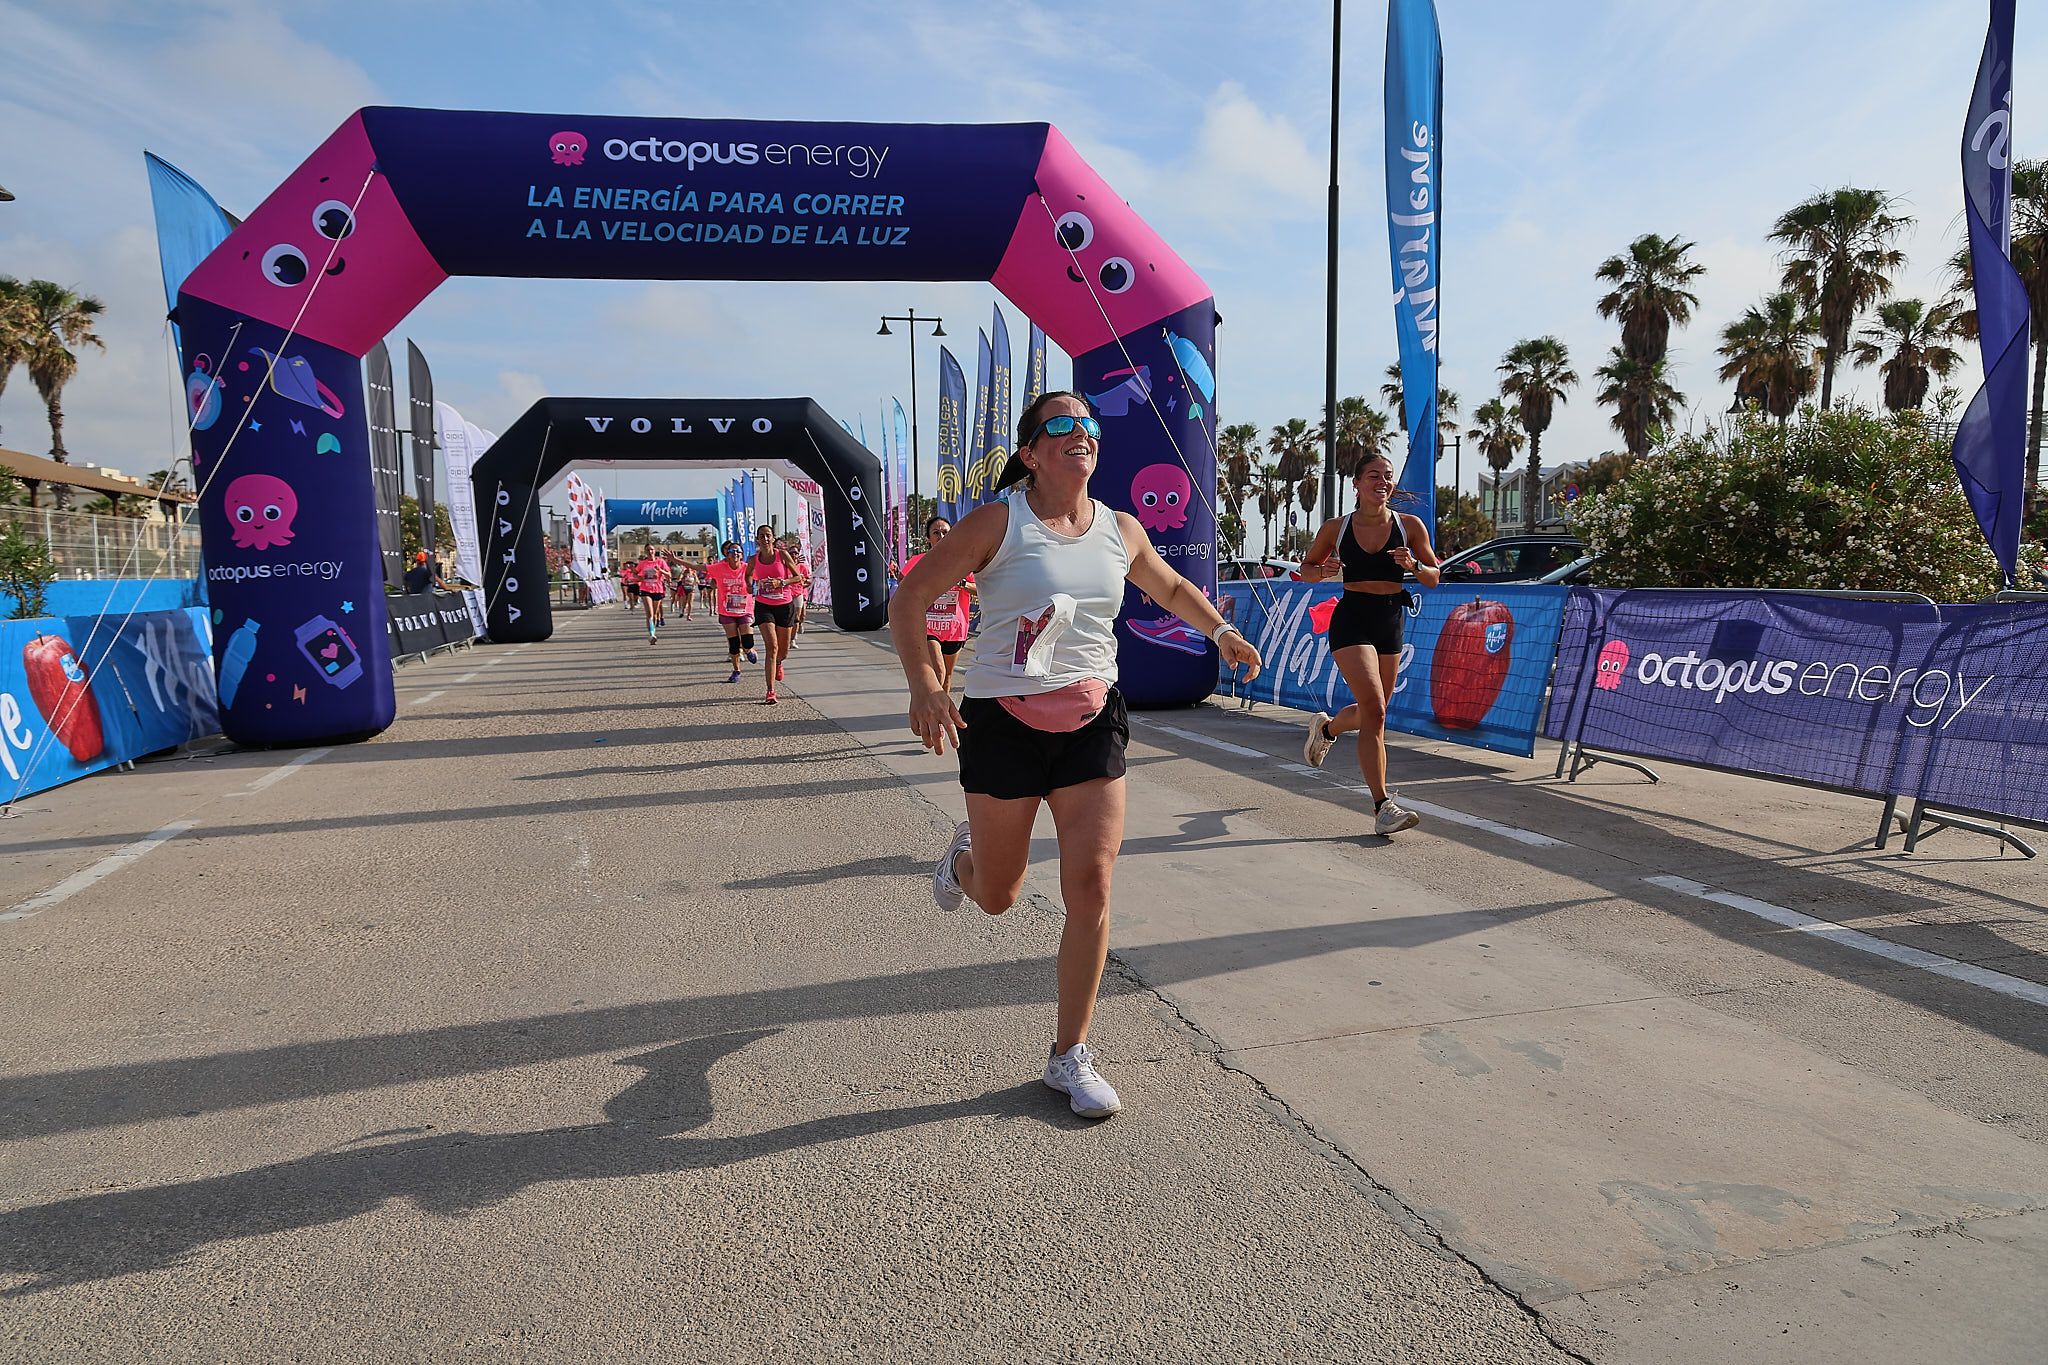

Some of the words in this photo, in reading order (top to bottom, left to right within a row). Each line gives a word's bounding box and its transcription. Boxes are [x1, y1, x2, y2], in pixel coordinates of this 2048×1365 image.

[603, 136, 760, 171] octopus
[764, 143, 889, 178] energy
[527, 185, 564, 208] LA
[573, 184, 699, 212] ENERGÍA
[708, 190, 785, 214] PARA
[793, 193, 905, 216] CORRER
[526, 218, 546, 239] A
[555, 219, 591, 240] LA
[601, 220, 764, 243] VELOCIDAD
[771, 225, 808, 244] DE
[815, 225, 849, 245] LA
[857, 226, 910, 246] LUZ
[584, 417, 773, 434] VOLVO
[640, 501, 689, 522] Marlene
[497, 490, 522, 624] VOLVO
[850, 486, 870, 612] VOLVO
[1168, 542, 1212, 560] energy
[208, 565, 272, 583] octopus
[272, 561, 344, 580] energy
[395, 612, 437, 632] VOLVO
[1256, 587, 1415, 709] Mare
[1637, 650, 1798, 704] octopus
[1799, 661, 1996, 731] energy
